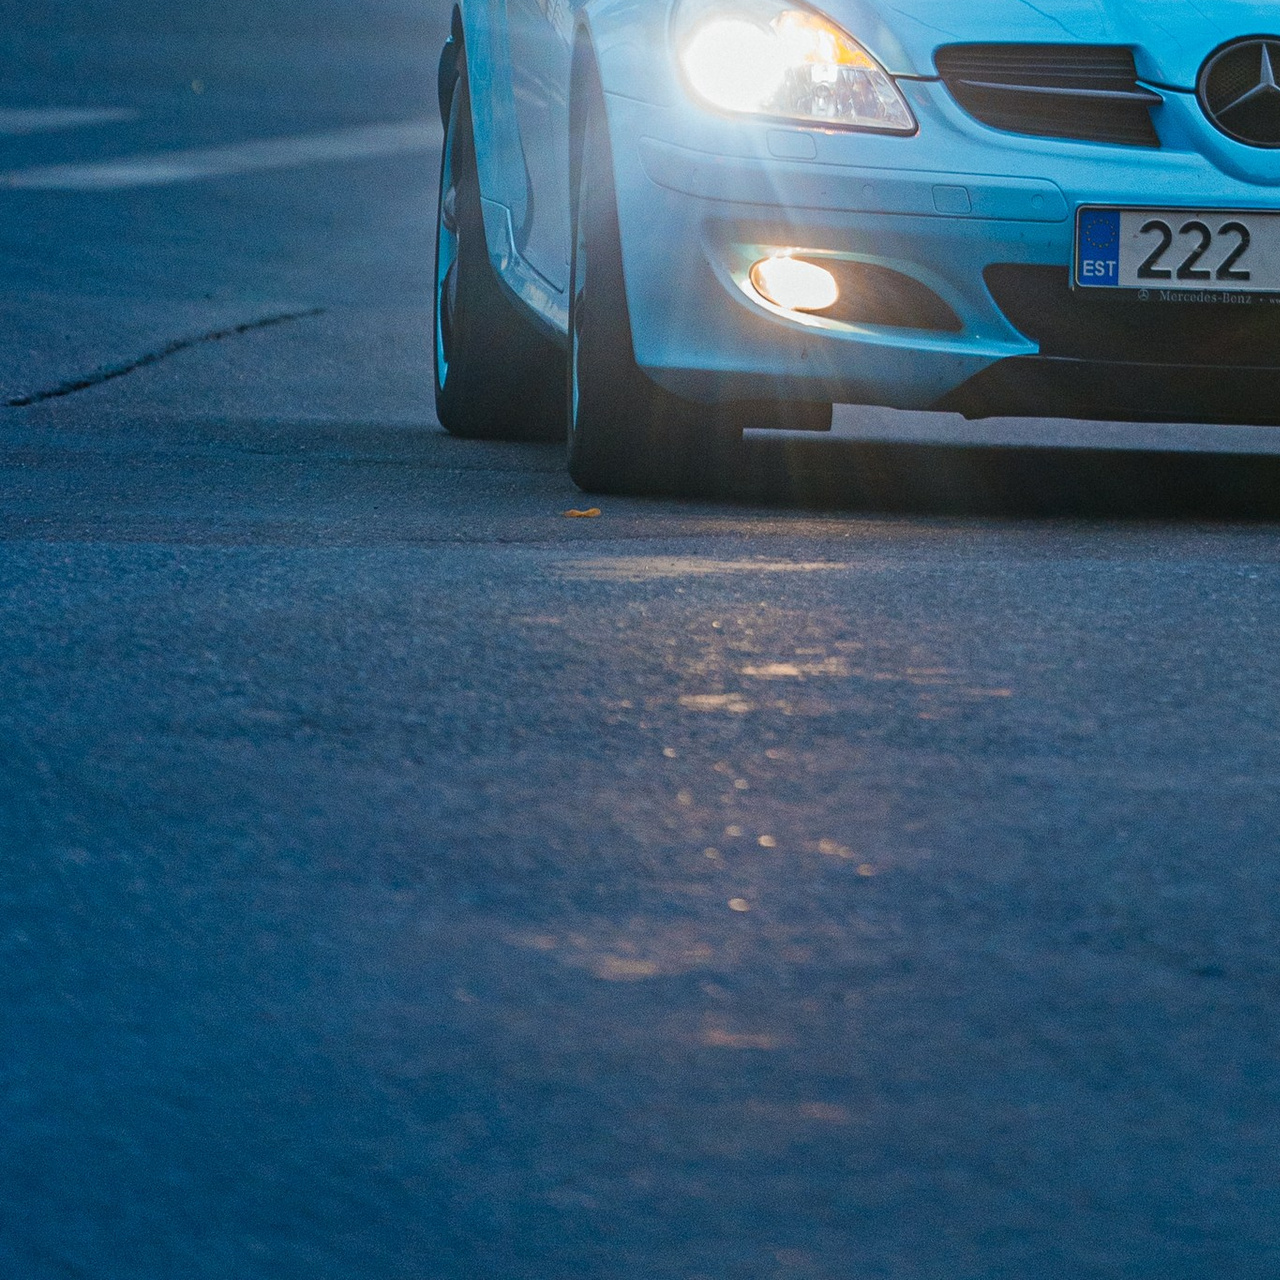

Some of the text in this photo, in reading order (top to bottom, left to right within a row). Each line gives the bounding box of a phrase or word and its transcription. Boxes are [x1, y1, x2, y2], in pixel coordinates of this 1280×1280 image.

[1136, 219, 1251, 281] 222
[1082, 259, 1117, 278] EST
[1159, 289, 1252, 304] Mercedes-Benz
